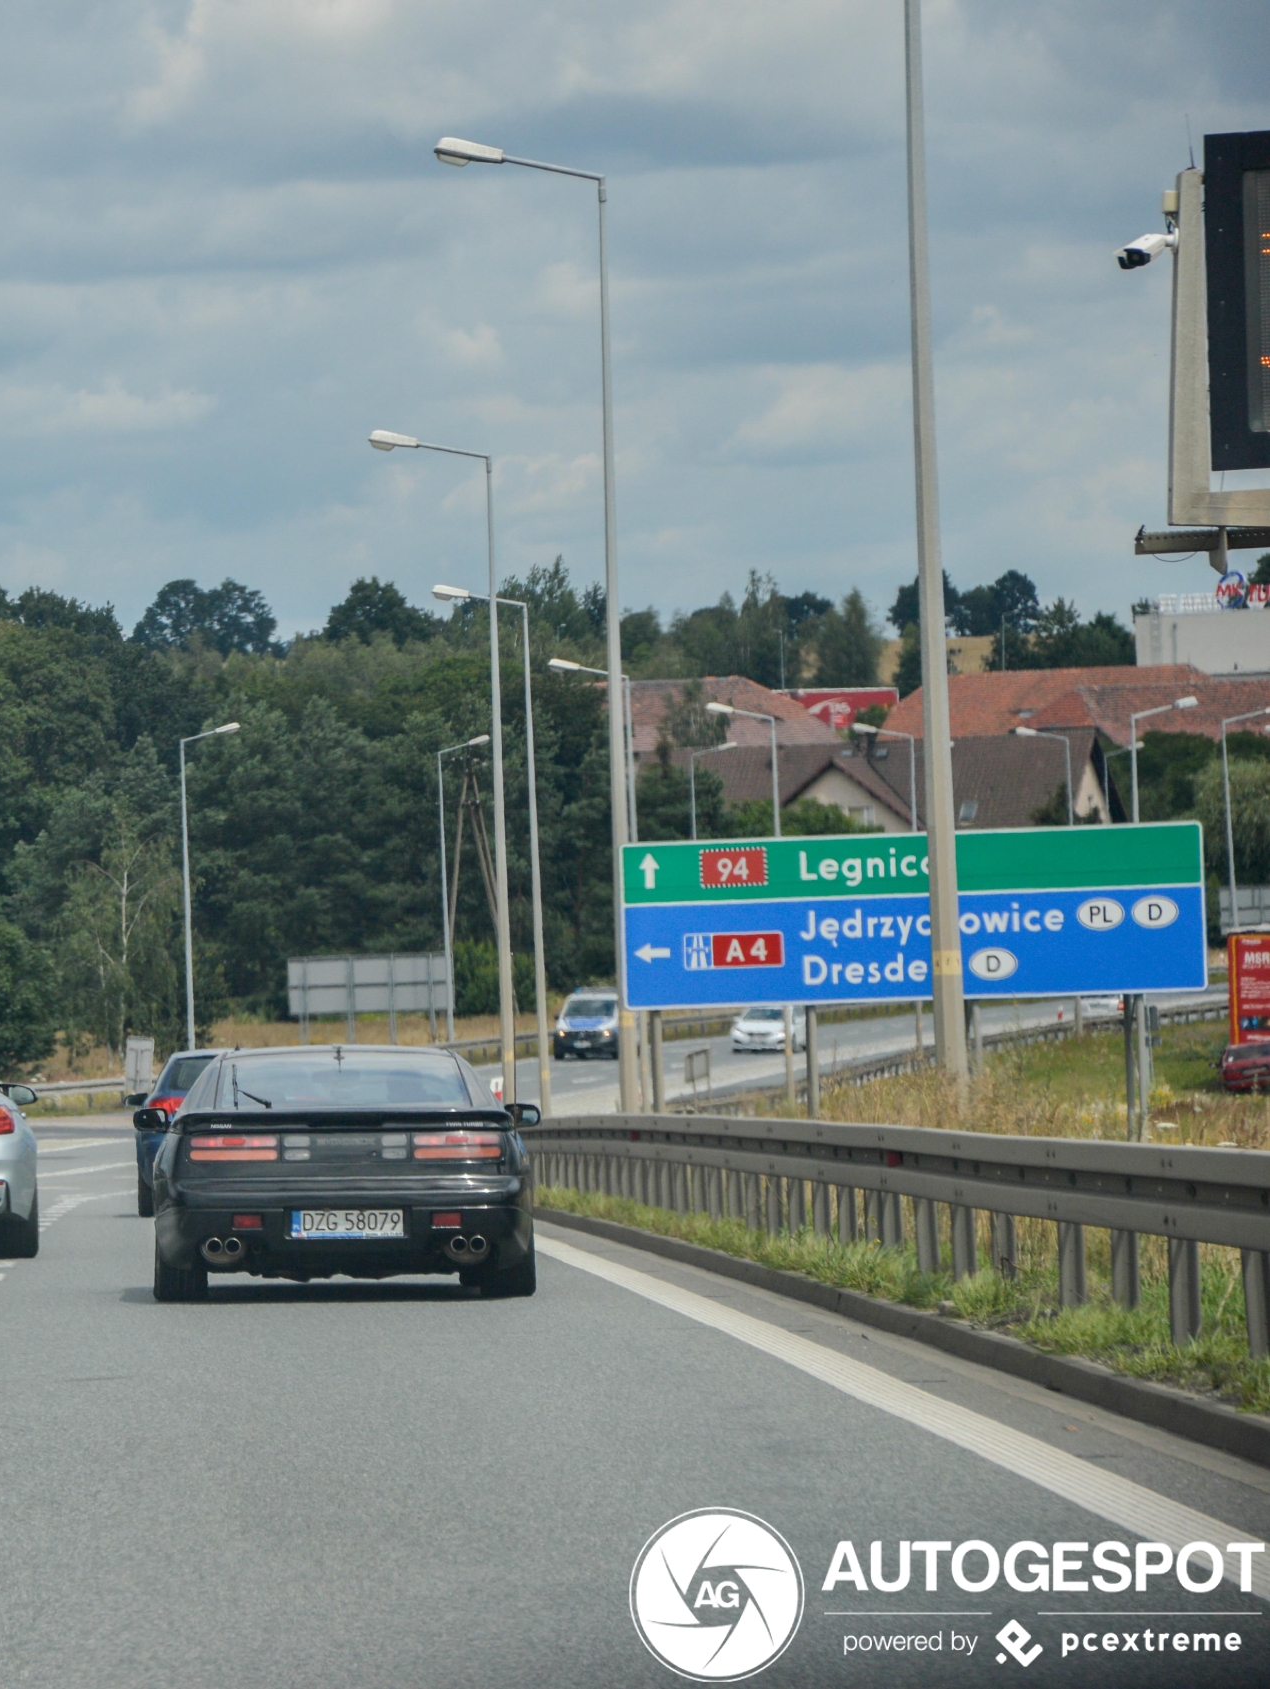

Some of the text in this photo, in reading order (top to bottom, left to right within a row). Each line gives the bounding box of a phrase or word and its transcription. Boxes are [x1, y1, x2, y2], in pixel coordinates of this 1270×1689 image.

[717, 858, 750, 882] 94
[800, 902, 1163, 948] Jędrzycowice PL D
[803, 952, 1001, 985] Dresde D
[302, 1212, 401, 1231] DZG 58079
